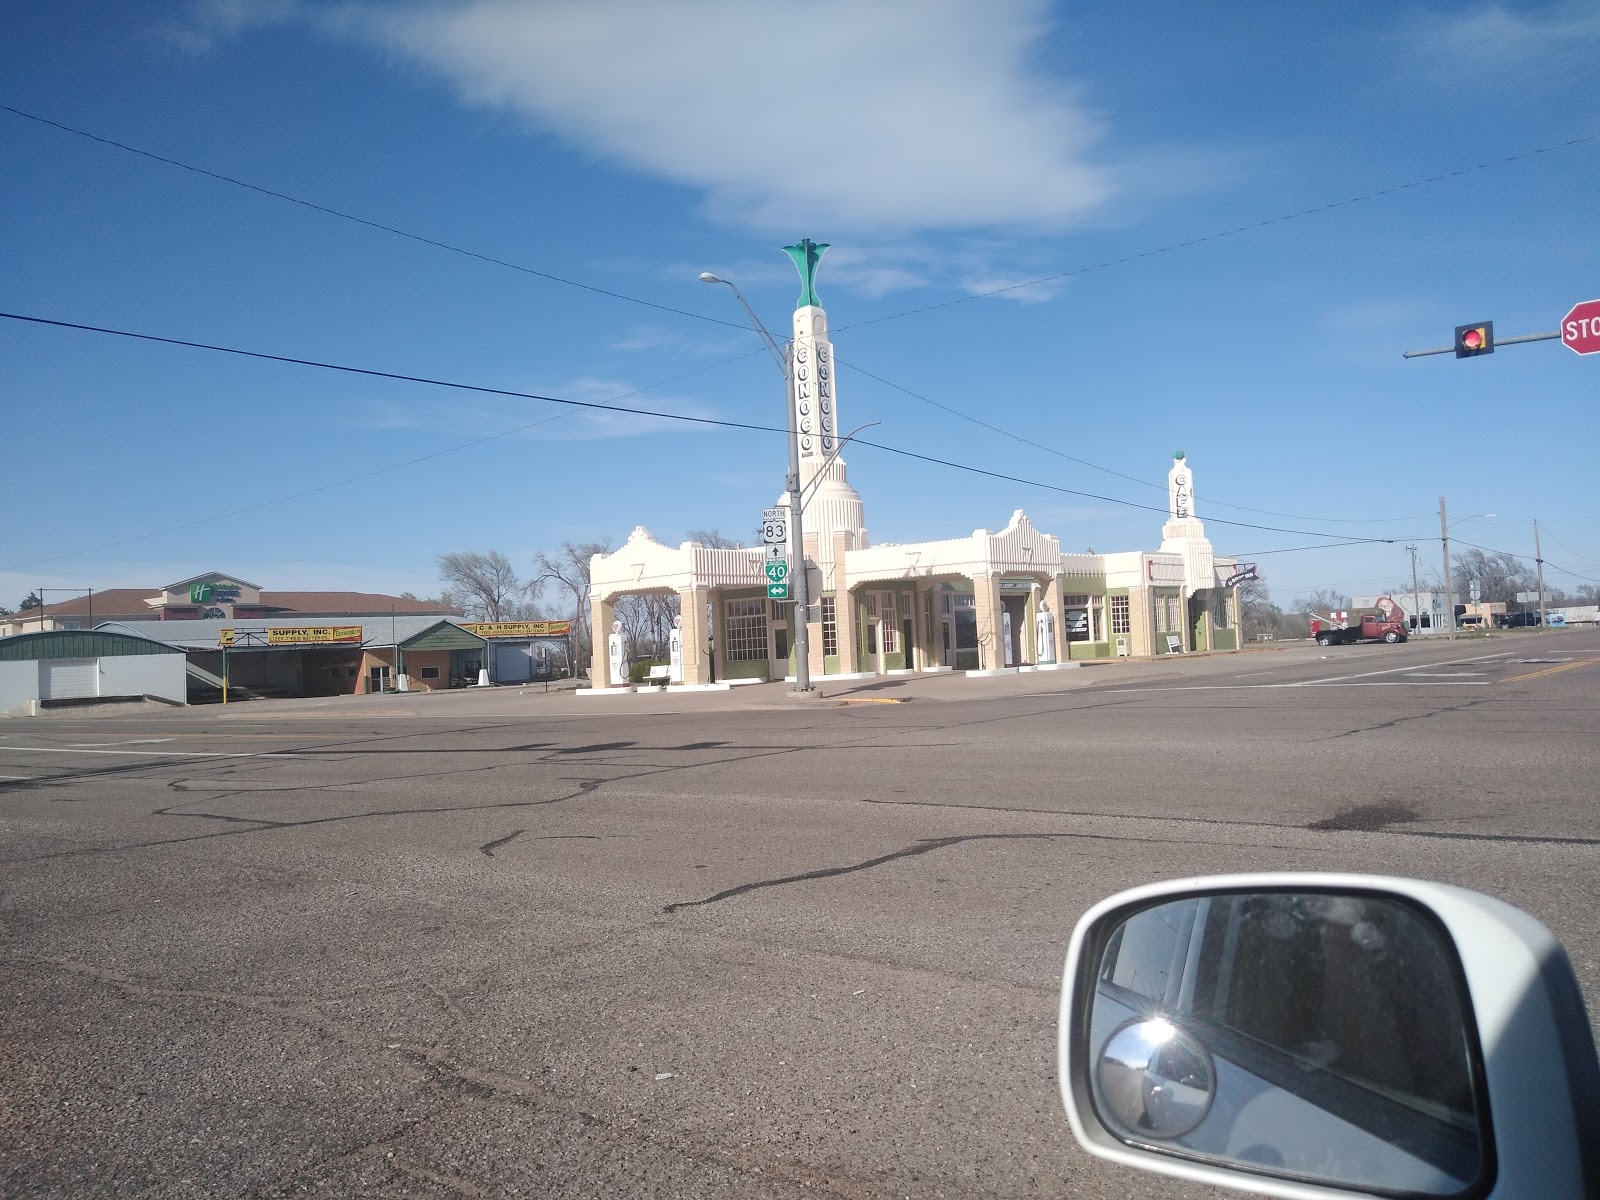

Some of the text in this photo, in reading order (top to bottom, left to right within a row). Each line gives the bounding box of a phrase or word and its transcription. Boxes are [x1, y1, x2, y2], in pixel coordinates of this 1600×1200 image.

[1566, 316, 1600, 340] STO
[797, 347, 813, 450] CONOCO
[818, 346, 832, 450] CONOCO
[1175, 474, 1188, 518] CAFE
[763, 510, 784, 518] NORTH
[765, 524, 784, 538] 83
[768, 566, 785, 578] 40
[272, 629, 309, 637] SUPPLY,
